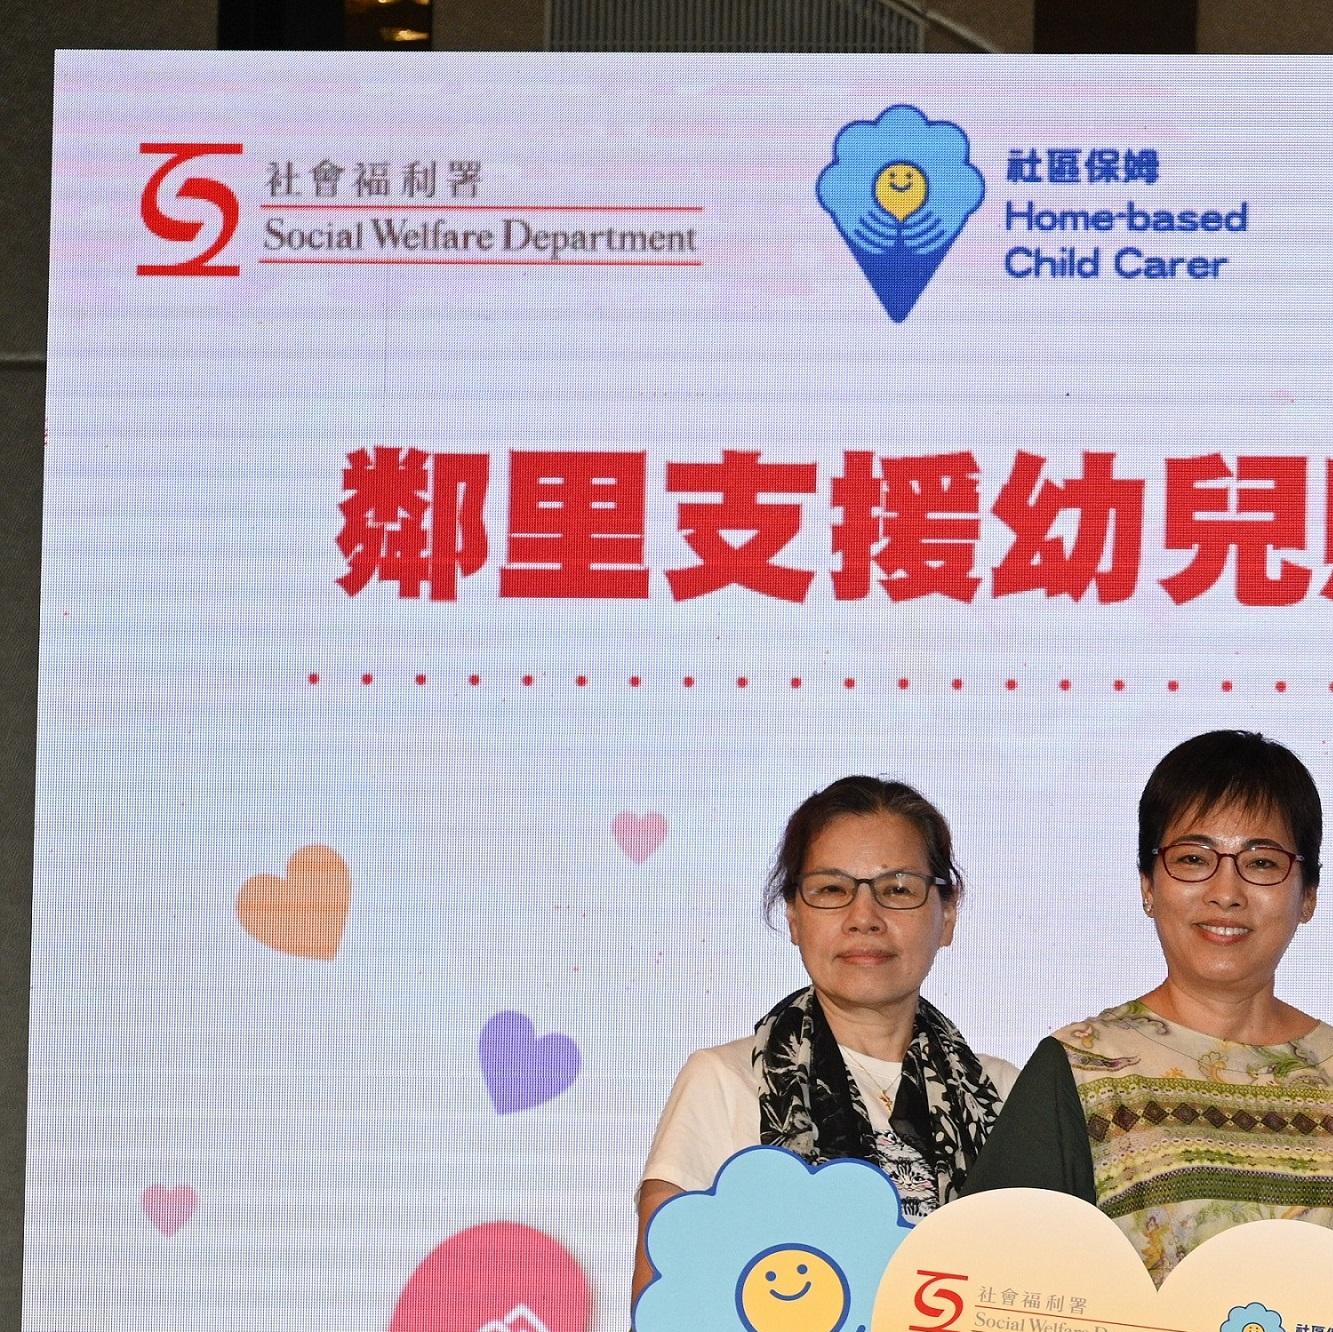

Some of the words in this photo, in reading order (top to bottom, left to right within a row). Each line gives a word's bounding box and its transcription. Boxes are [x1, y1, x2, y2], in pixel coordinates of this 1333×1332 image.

[264, 159, 483, 199] 社會福利署
[1006, 148, 1160, 186] 社區保姆
[1004, 200, 1249, 232] Home-based
[263, 219, 363, 251] Social
[370, 218, 496, 251] Welfare
[502, 218, 697, 259] Department
[1004, 246, 1099, 279] Child
[1114, 246, 1229, 280] Carer
[978, 1285, 1088, 1315] 社會福利署
[974, 1311, 1025, 1332] Social
